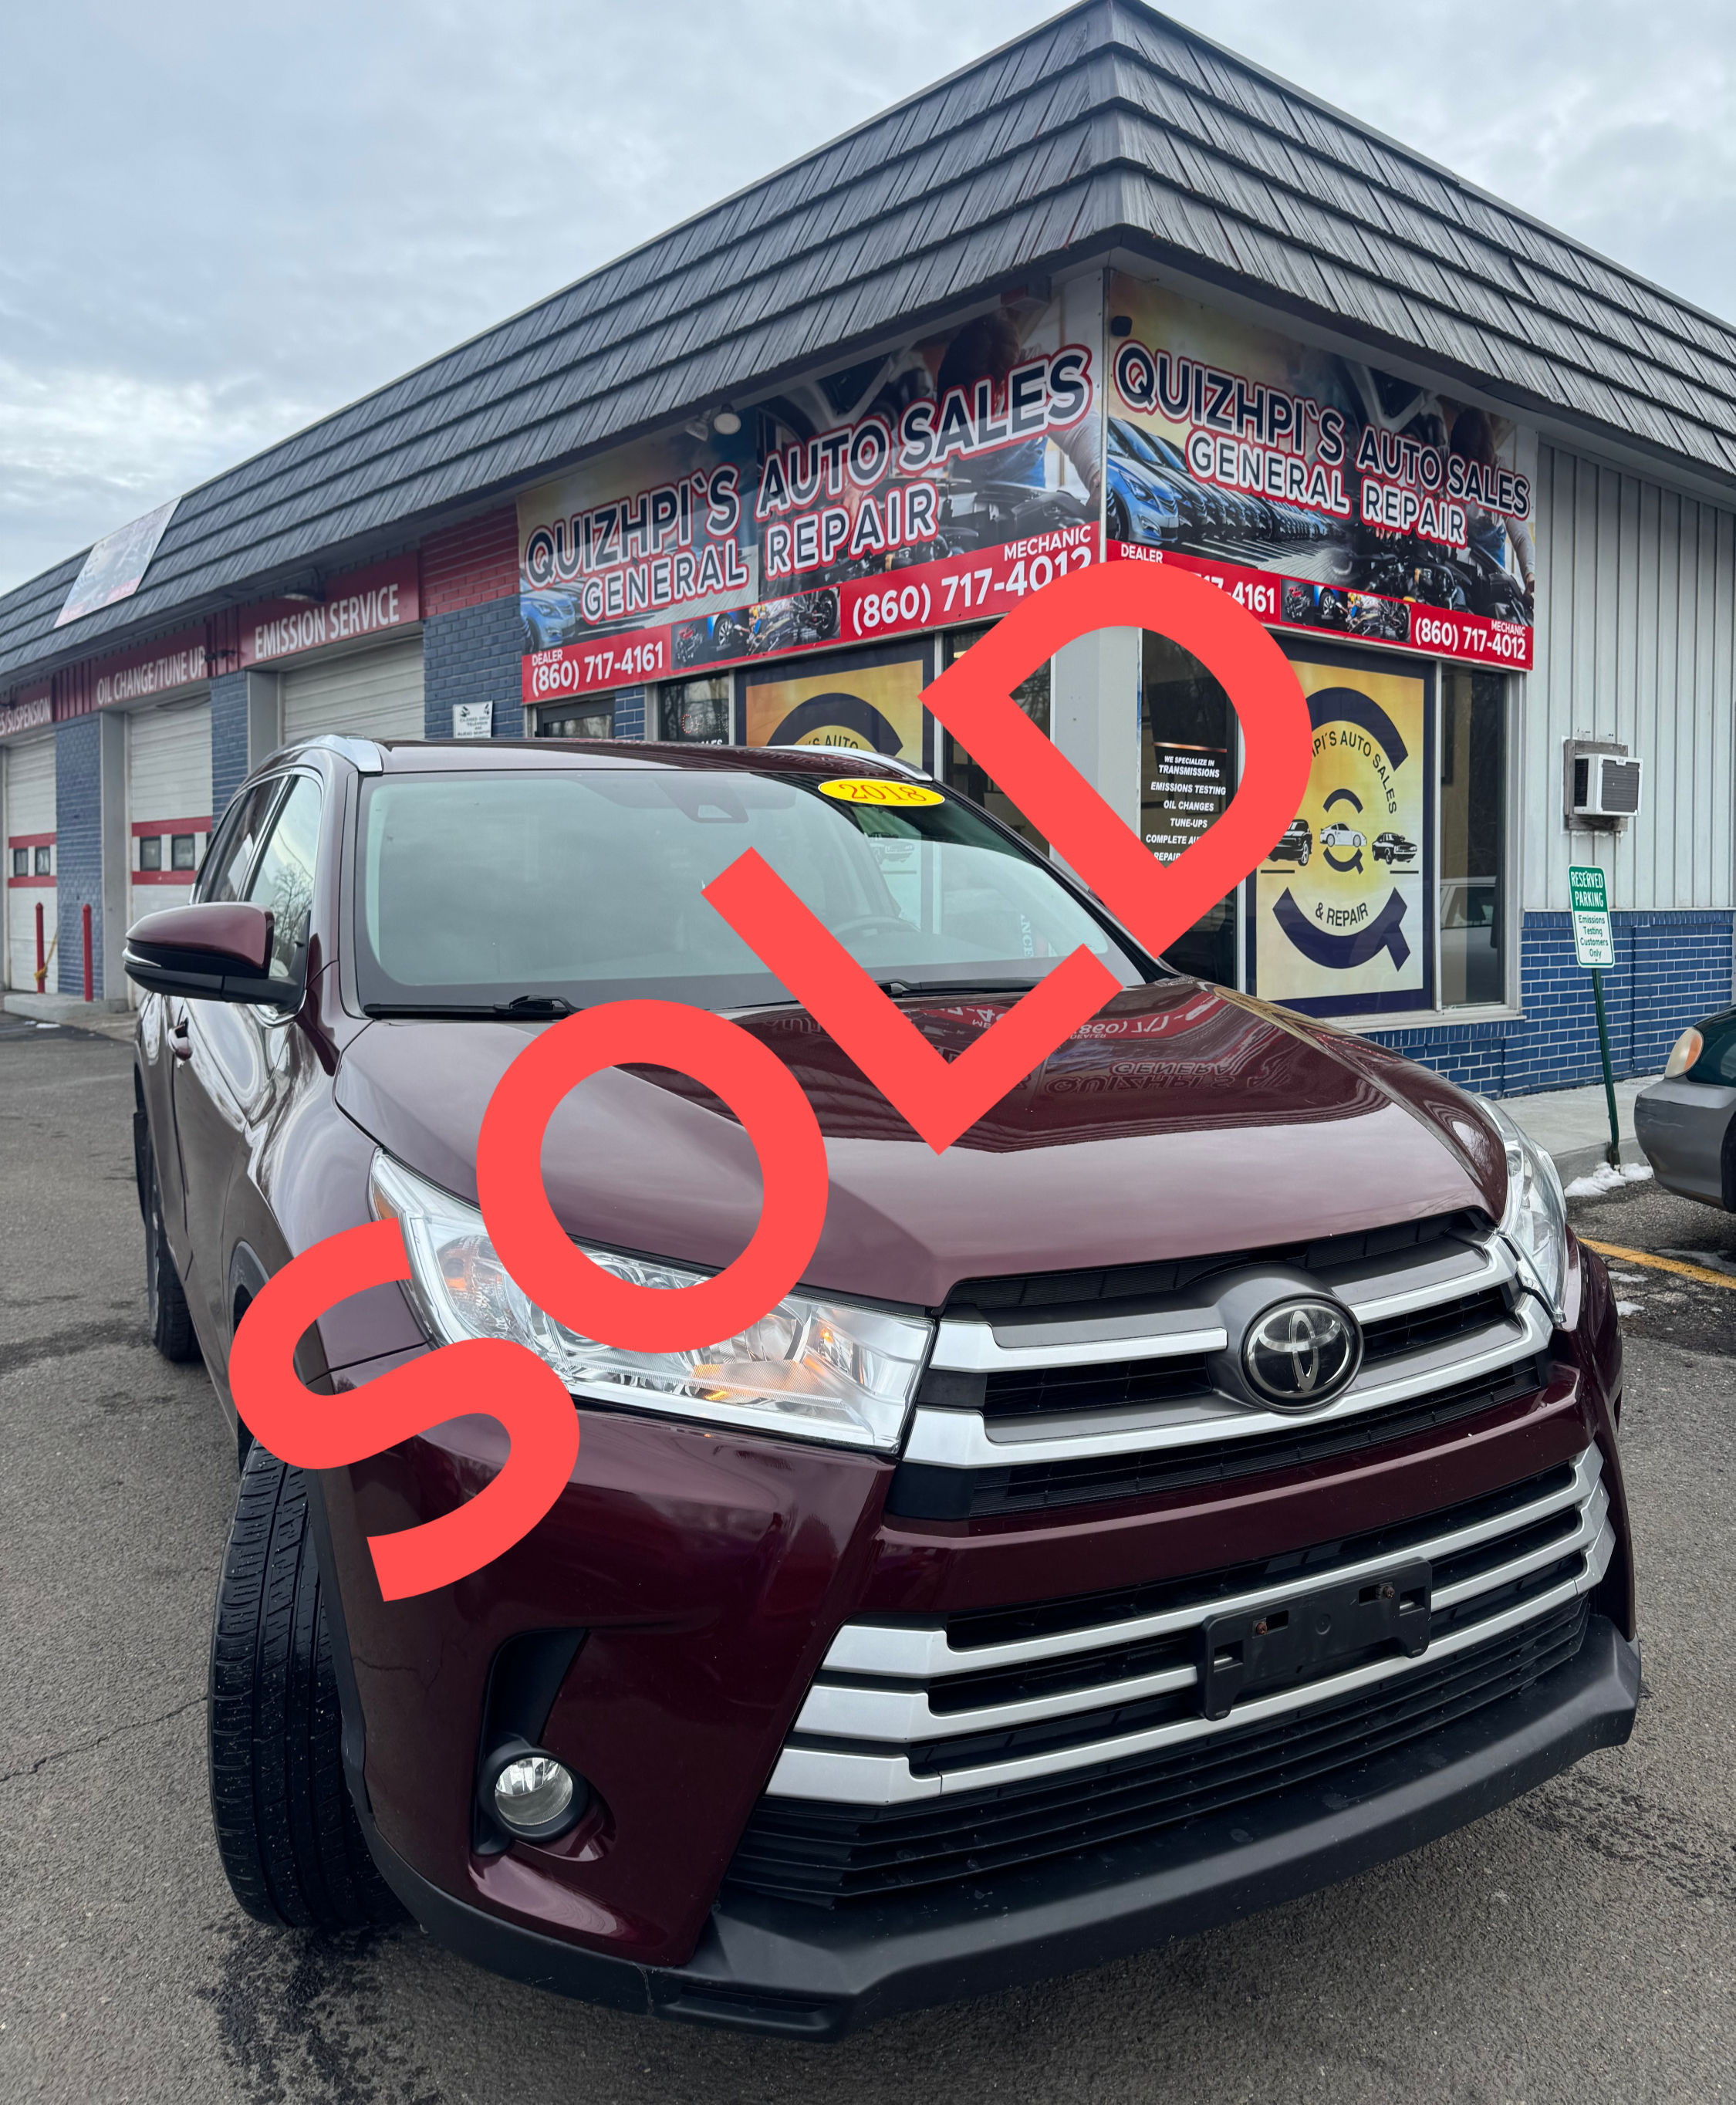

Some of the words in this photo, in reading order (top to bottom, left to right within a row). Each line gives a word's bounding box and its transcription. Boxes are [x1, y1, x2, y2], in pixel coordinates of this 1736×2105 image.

[755, 420, 890, 518] AUTO
[899, 347, 1092, 471] SALES
[1355, 425, 1444, 492] AUTO
[1447, 455, 1530, 520] SALES
[1188, 427, 1352, 516] GENERAL
[1363, 478, 1467, 546] REPAIR
[1004, 525, 1091, 562] MECHANIC
[582, 538, 748, 622] GENERAL
[766, 484, 938, 577] REPAIR
[1121, 544, 1164, 563] DEALER
[853, 582, 931, 637] (860)
[941, 546, 1092, 612] 717-4012
[255, 606, 326, 660] EMISSION
[329, 583, 400, 639] SERVICE
[1491, 620, 1525, 637] MECHANIC
[1415, 617, 1458, 652] (860)
[1463, 626, 1525, 661] 717-4012
[532, 649, 563, 667] DEALER
[96, 675, 113, 706] OIL
[113, 651, 187, 701] CHANGE/TUNE
[189, 645, 206, 678] UP
[532, 659, 579, 698] (860)
[584, 641, 663, 684] 717-4161
[1174, 757, 1207, 766] SPECIALIZE
[1158, 765, 1220, 778] TRANSMISSIONS
[1340, 730, 1372, 757] AUTO
[1373, 753, 1397, 815] SALES
[838, 783, 927, 802] 2018
[1150, 782, 1193, 792] EMISSIONS
[1194, 785, 1226, 796] TESTING
[1164, 800, 1176, 809] OIL
[1178, 801, 1214, 812] CHANGES
[1170, 818, 1207, 828] TUNE-UPS
[1145, 834, 1187, 845] COMPLETE
[1570, 870, 1603, 888] RESERVED
[1574, 891, 1604, 907] PARKING
[1316, 902, 1323, 921] &
[1326, 902, 1369, 927] REPAIR
[1578, 915, 1606, 924] Emissions
[1582, 926, 1603, 937] Testing
[1580, 938, 1609, 946] Customers
[1589, 949, 1602, 958] Only
